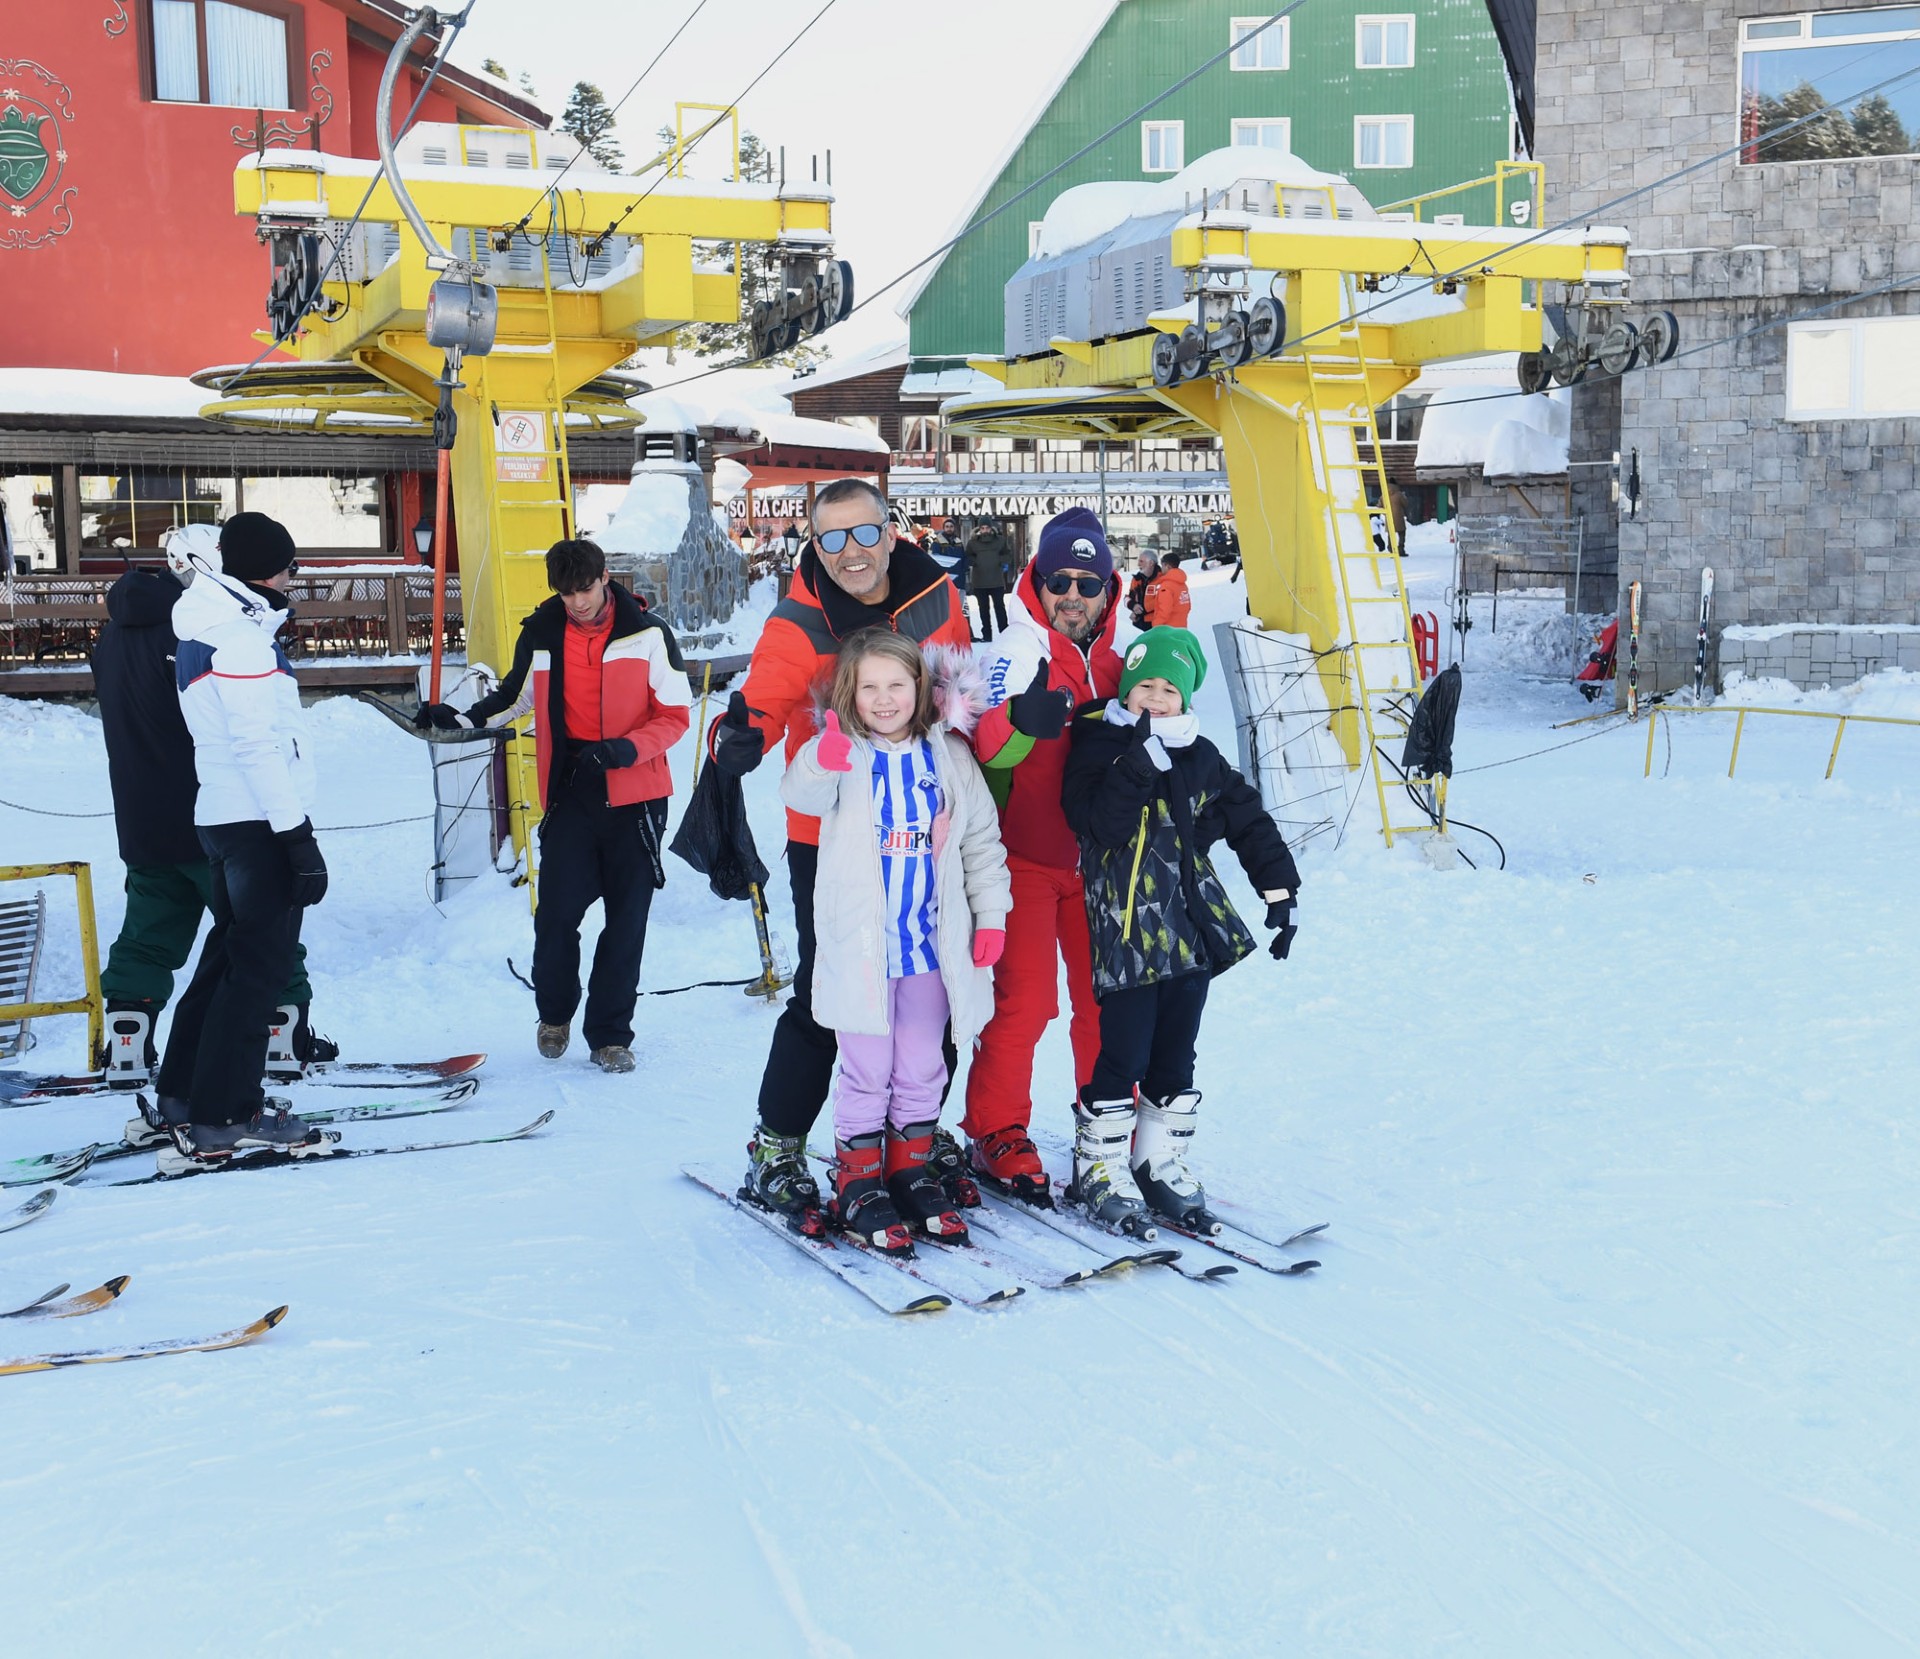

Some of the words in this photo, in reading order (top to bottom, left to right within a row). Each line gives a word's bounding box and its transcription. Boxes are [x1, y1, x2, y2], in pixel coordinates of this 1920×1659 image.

[729, 499, 770, 518] SORA
[772, 499, 804, 518] CAFE
[947, 497, 993, 516] HOCA
[996, 496, 1050, 515] KAYAK
[1160, 494, 1234, 514] KiRALAM
